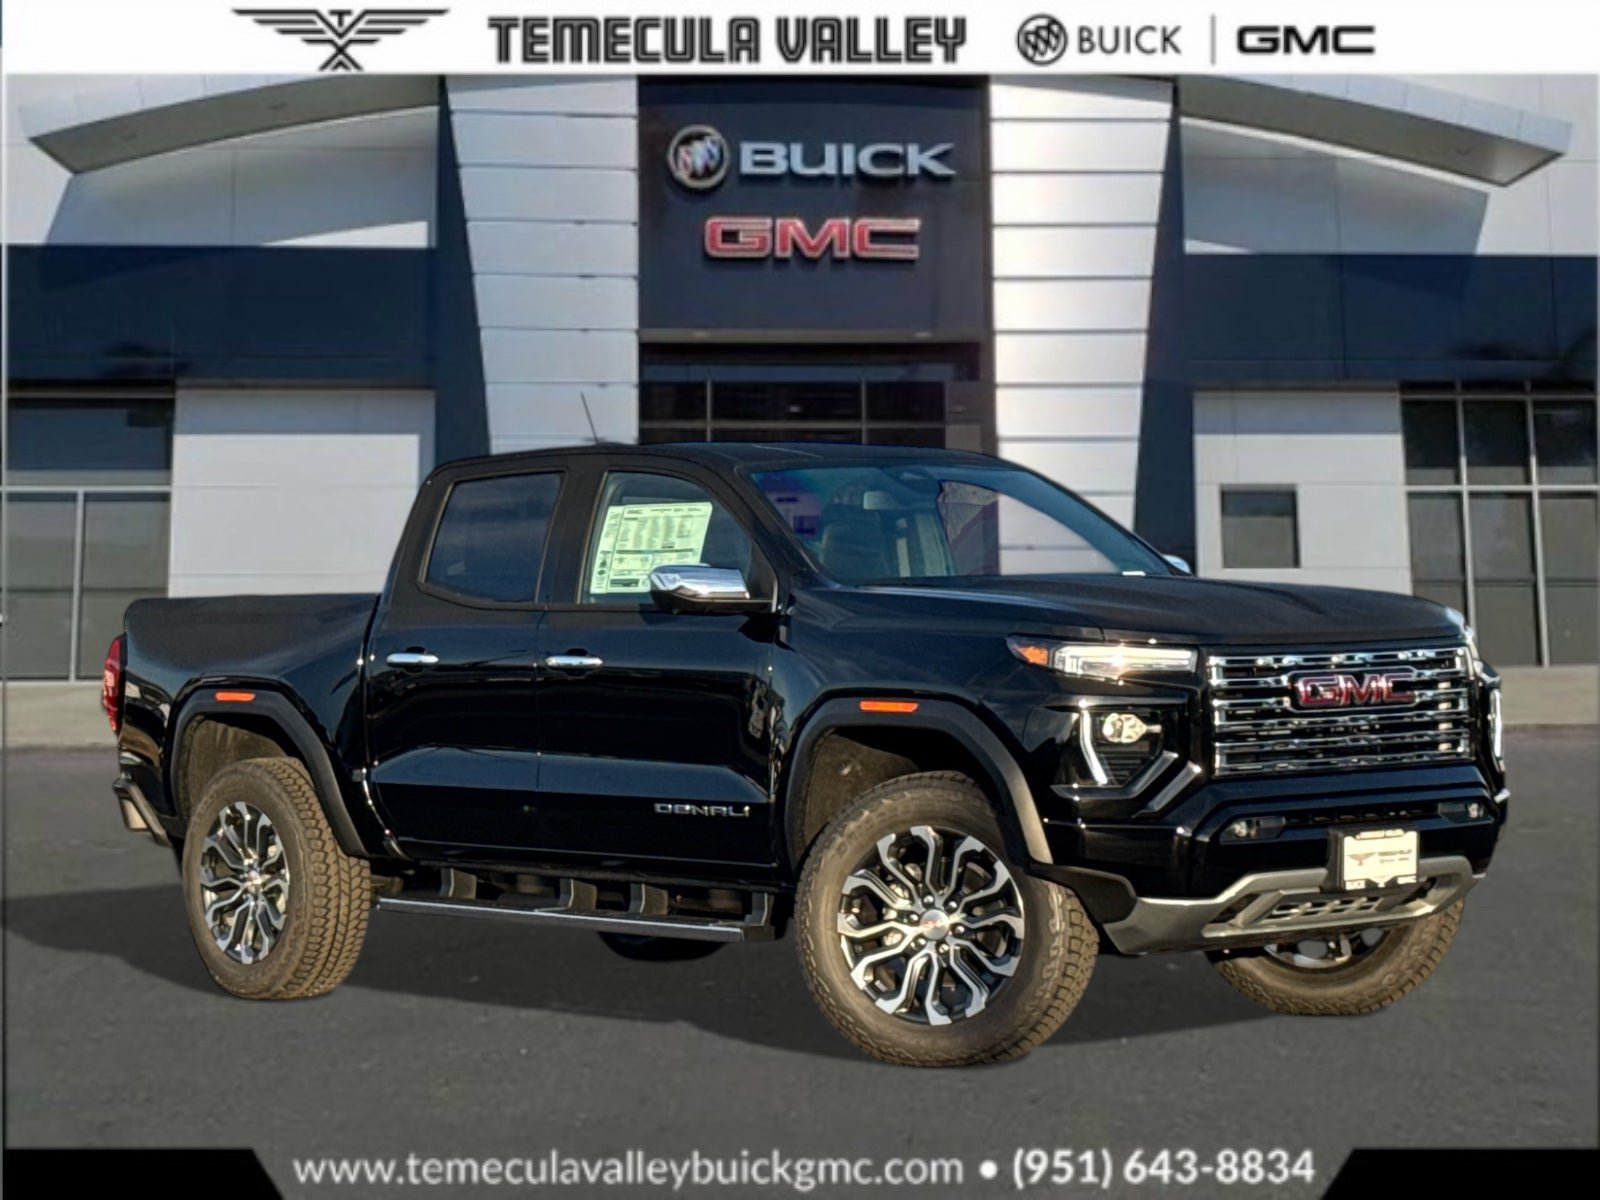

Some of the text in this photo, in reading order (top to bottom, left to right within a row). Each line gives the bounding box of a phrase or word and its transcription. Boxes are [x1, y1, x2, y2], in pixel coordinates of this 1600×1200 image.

[738, 140, 956, 177] BUICK
[704, 216, 921, 260] GMC
[1294, 672, 1414, 707] GMC
[654, 803, 750, 818] DENALI
